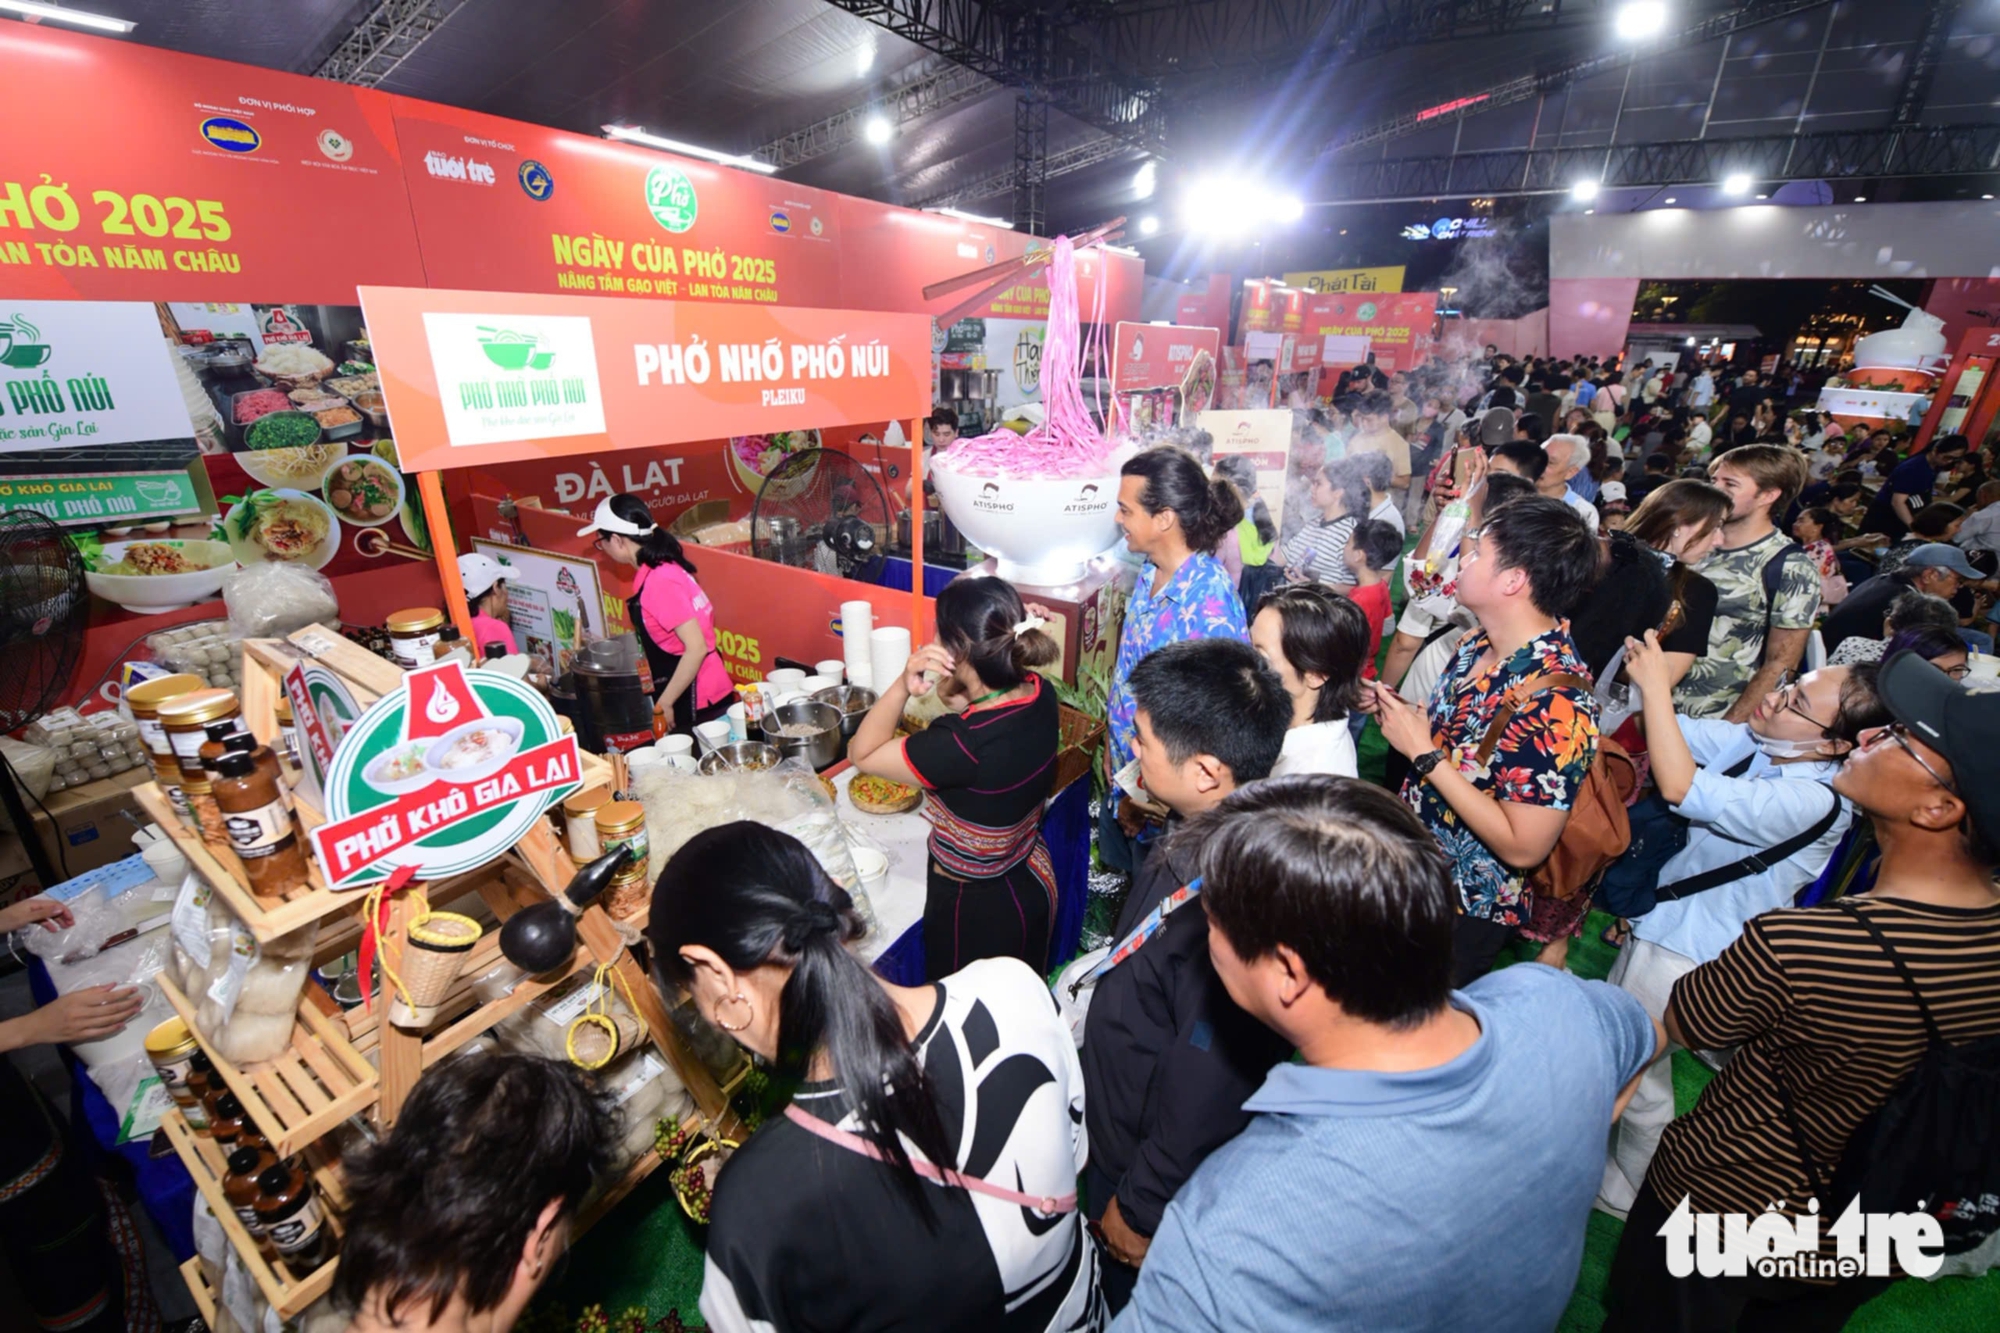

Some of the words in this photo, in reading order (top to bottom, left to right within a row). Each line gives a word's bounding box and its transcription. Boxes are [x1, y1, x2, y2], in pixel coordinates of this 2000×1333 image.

[92, 190, 231, 242] 2025
[34, 238, 99, 268] TỎA
[102, 244, 168, 271] NĂM
[173, 248, 241, 274] CHÂU
[552, 232, 624, 270] NGÀY
[631, 238, 679, 275] CỦA
[683, 246, 727, 280] PHỞ
[731, 255, 777, 284] 2025
[558, 272, 596, 290] NÂNG
[627, 277, 652, 296] GẠO
[654, 277, 679, 295] VIỆT
[689, 282, 709, 298] LAN
[731, 284, 753, 300] NĂM
[754, 286, 778, 303] CHÂU
[634, 334, 711, 386] PHỞ
[718, 337, 784, 382] NHỚ
[791, 334, 847, 380] PHỐ
[851, 339, 890, 378] NÚI
[5, 369, 66, 416] PHỐ
[66, 372, 116, 413] NÚI
[761, 387, 806, 407] PLEIKU
[19, 426, 46, 440] sản
[47, 421, 75, 443] Gia
[76, 420, 100, 437] Lai
[17, 482, 54, 495] KHÔ
[58, 482, 86, 493] GIA
[89, 481, 115, 493] LAI
[105, 494, 138, 513] NÚI
[554, 461, 615, 504] ĐÀ
[622, 457, 684, 495] LẠT
[603, 590, 623, 620] ÀY
[715, 628, 761, 664] 2025
[334, 814, 402, 873] PHỞ
[407, 787, 468, 835] KHÔ
[473, 778, 521, 807] GIA
[526, 753, 572, 789] LAI
